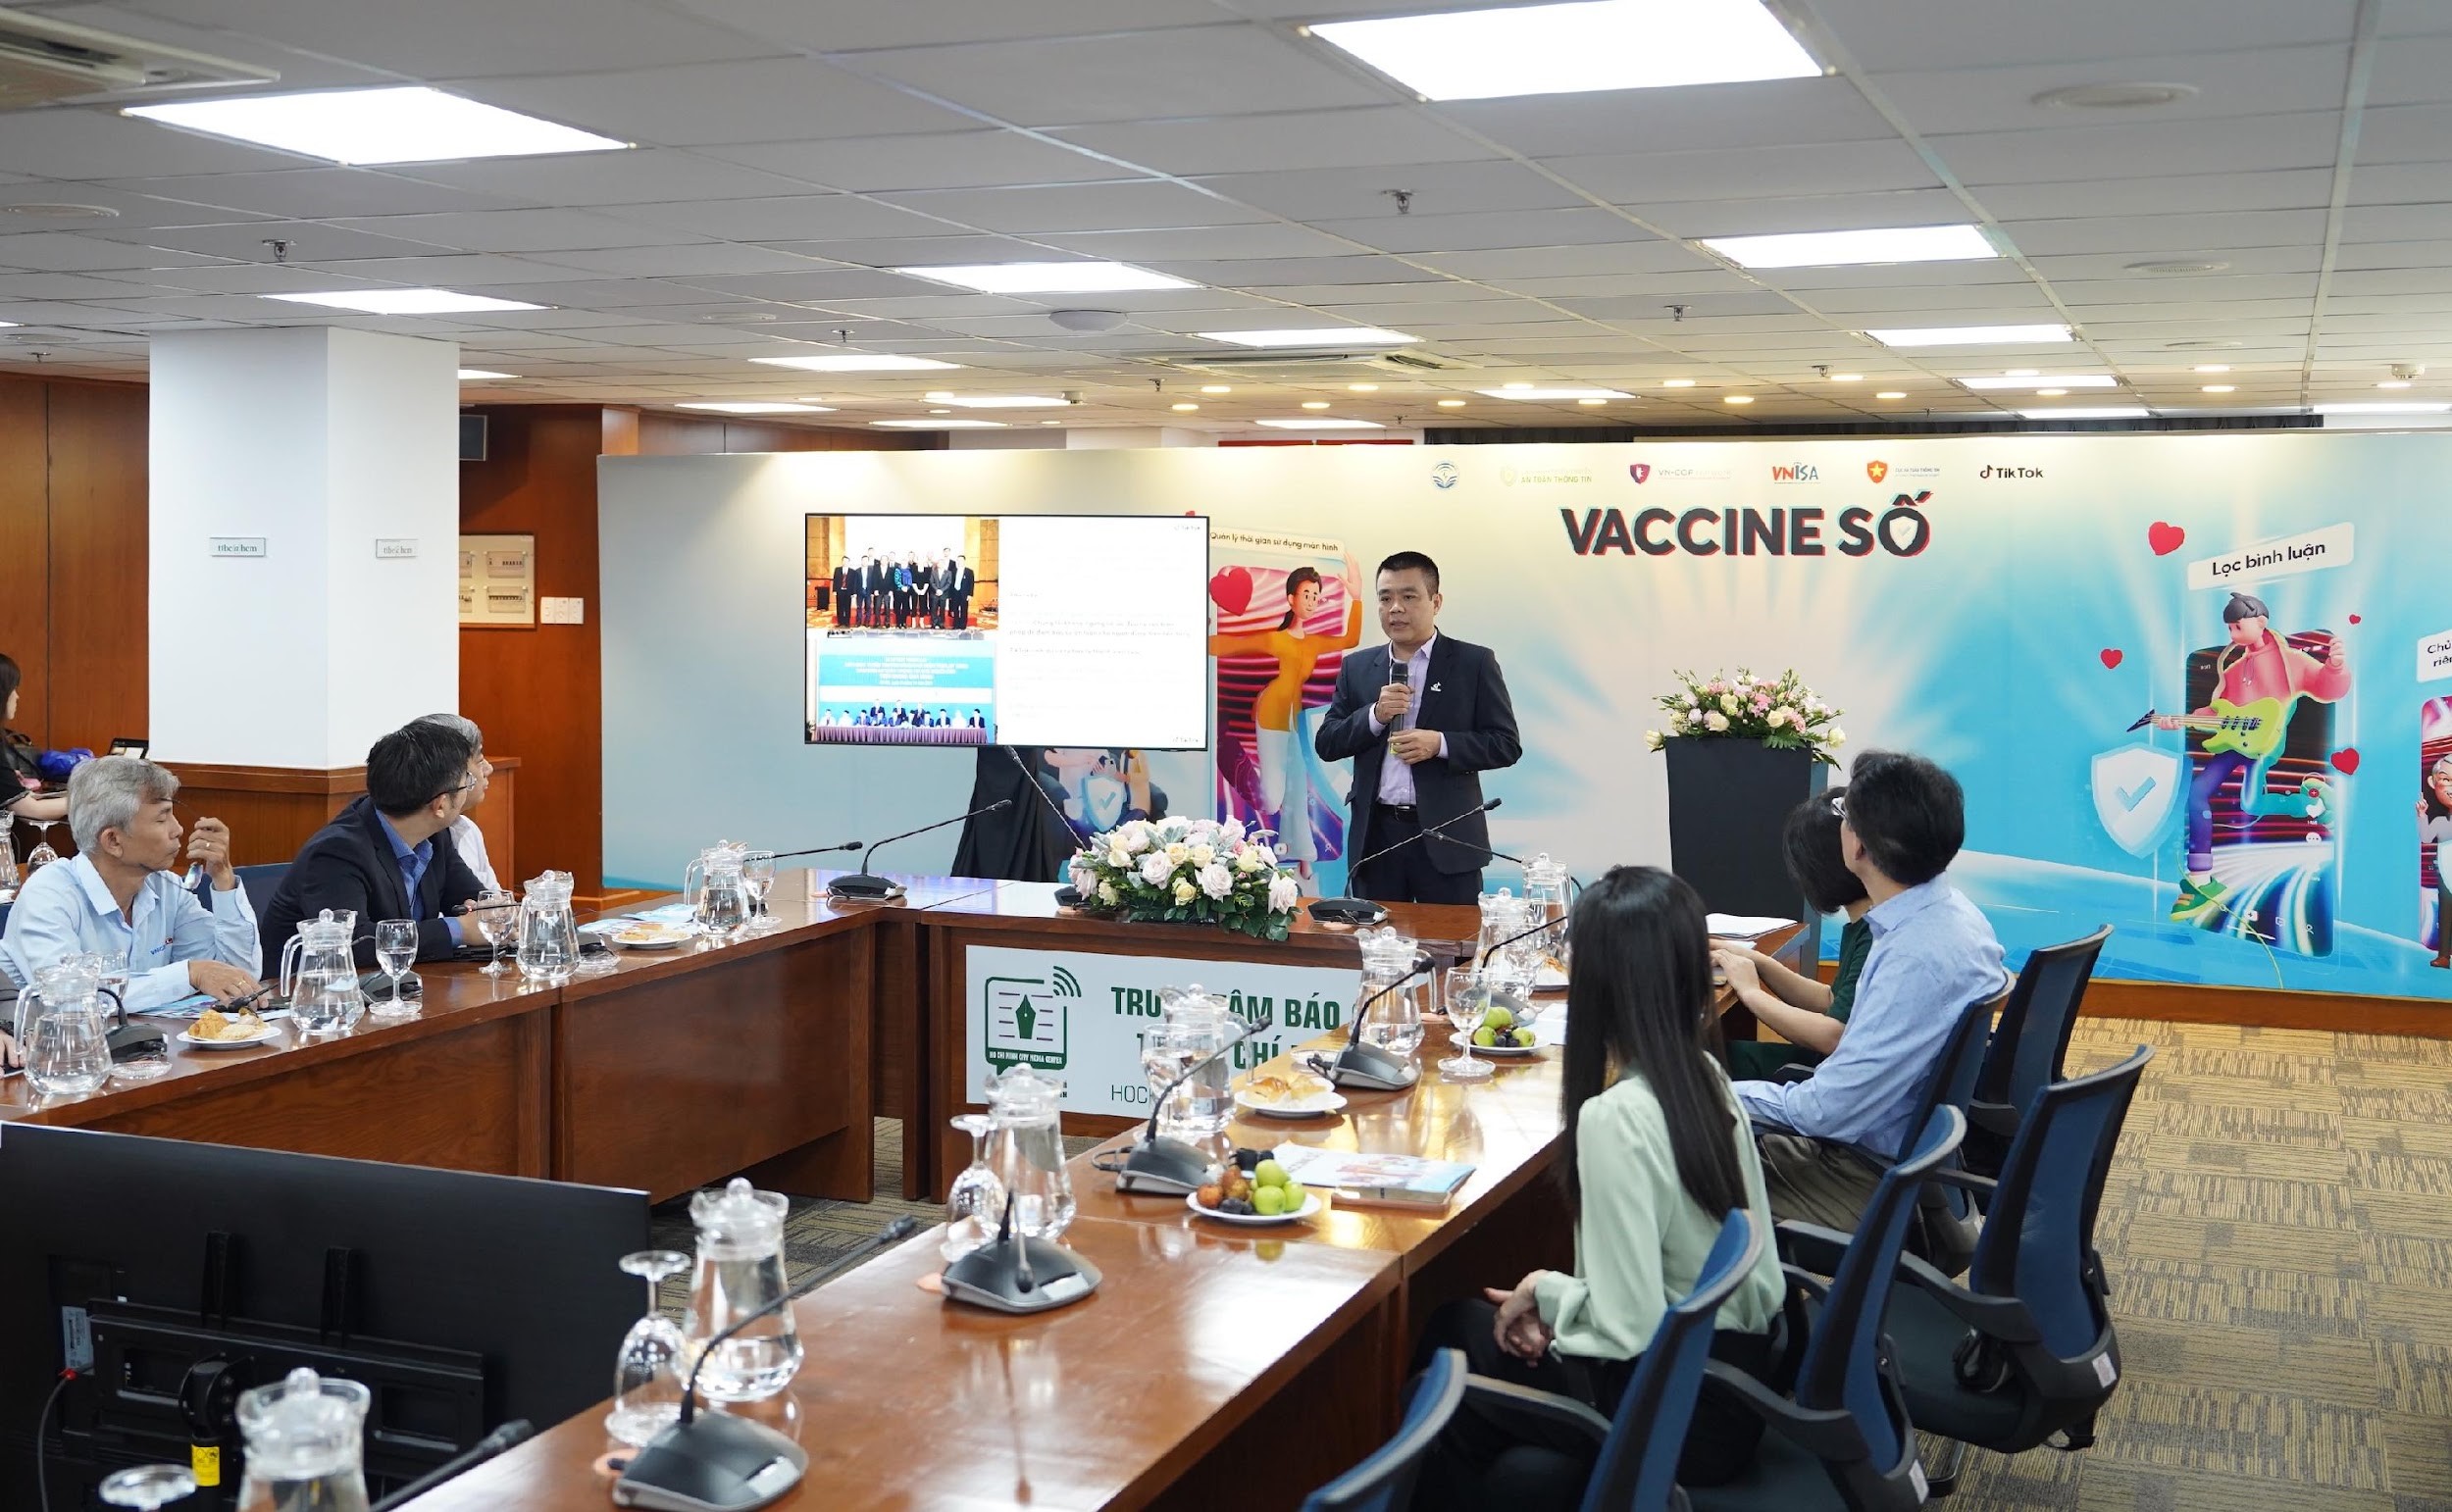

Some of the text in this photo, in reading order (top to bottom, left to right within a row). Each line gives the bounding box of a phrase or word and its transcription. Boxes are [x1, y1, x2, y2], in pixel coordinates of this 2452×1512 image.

[1996, 468, 2043, 479] TikTok
[1559, 490, 1933, 557] VACCINE SỐ
[2213, 561, 2241, 577] Lọc
[2288, 544, 2325, 561] luận
[1285, 992, 1340, 1030] BÁO
[1234, 1035, 1282, 1069] CHÍ
